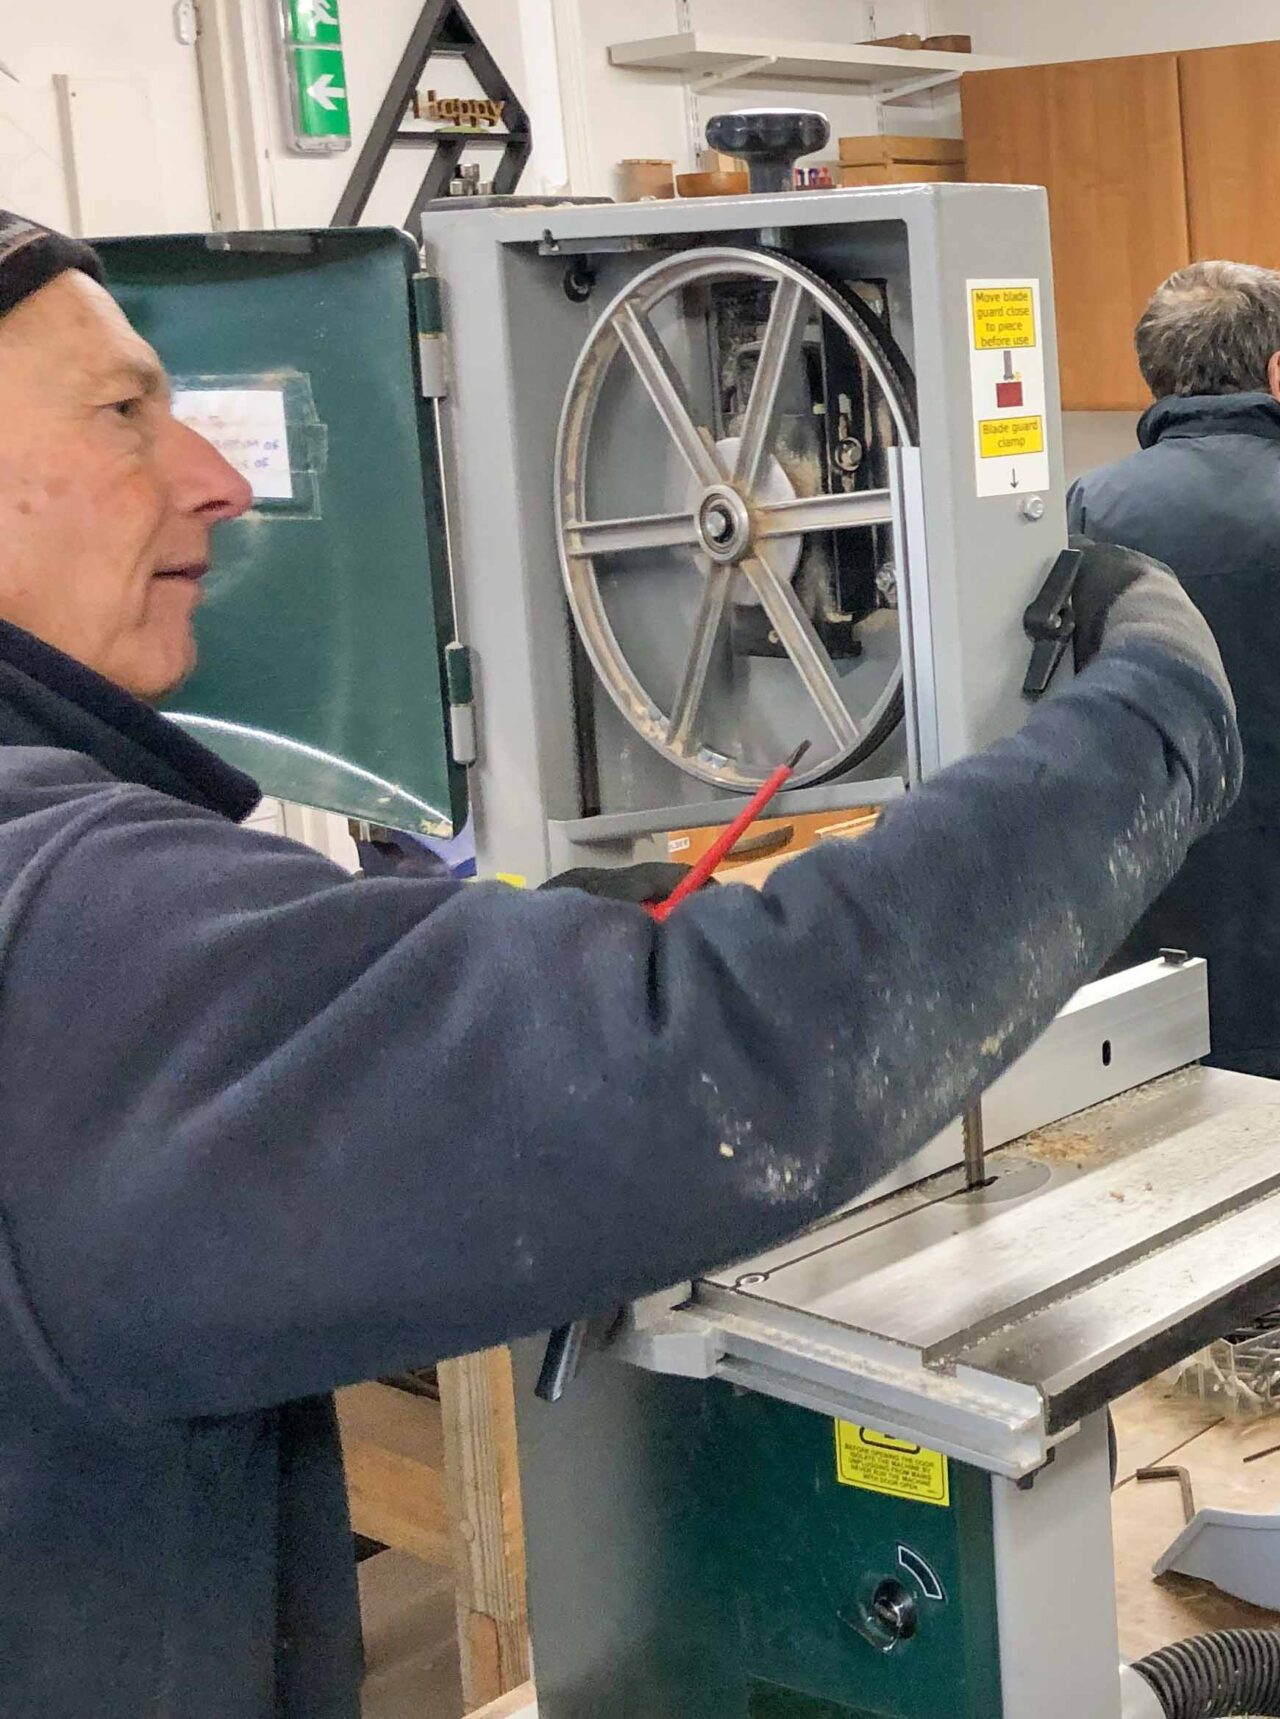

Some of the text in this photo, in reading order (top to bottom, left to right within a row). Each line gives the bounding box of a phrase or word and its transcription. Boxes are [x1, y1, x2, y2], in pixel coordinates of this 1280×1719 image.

[413, 90, 505, 128] Happy
[976, 291, 1029, 302] Move blade
[977, 306, 1029, 320] guard close
[986, 321, 1023, 333] to piece
[981, 336, 1029, 347] before use
[982, 421, 1038, 434] Blade guard
[998, 437, 1026, 448] clamp
